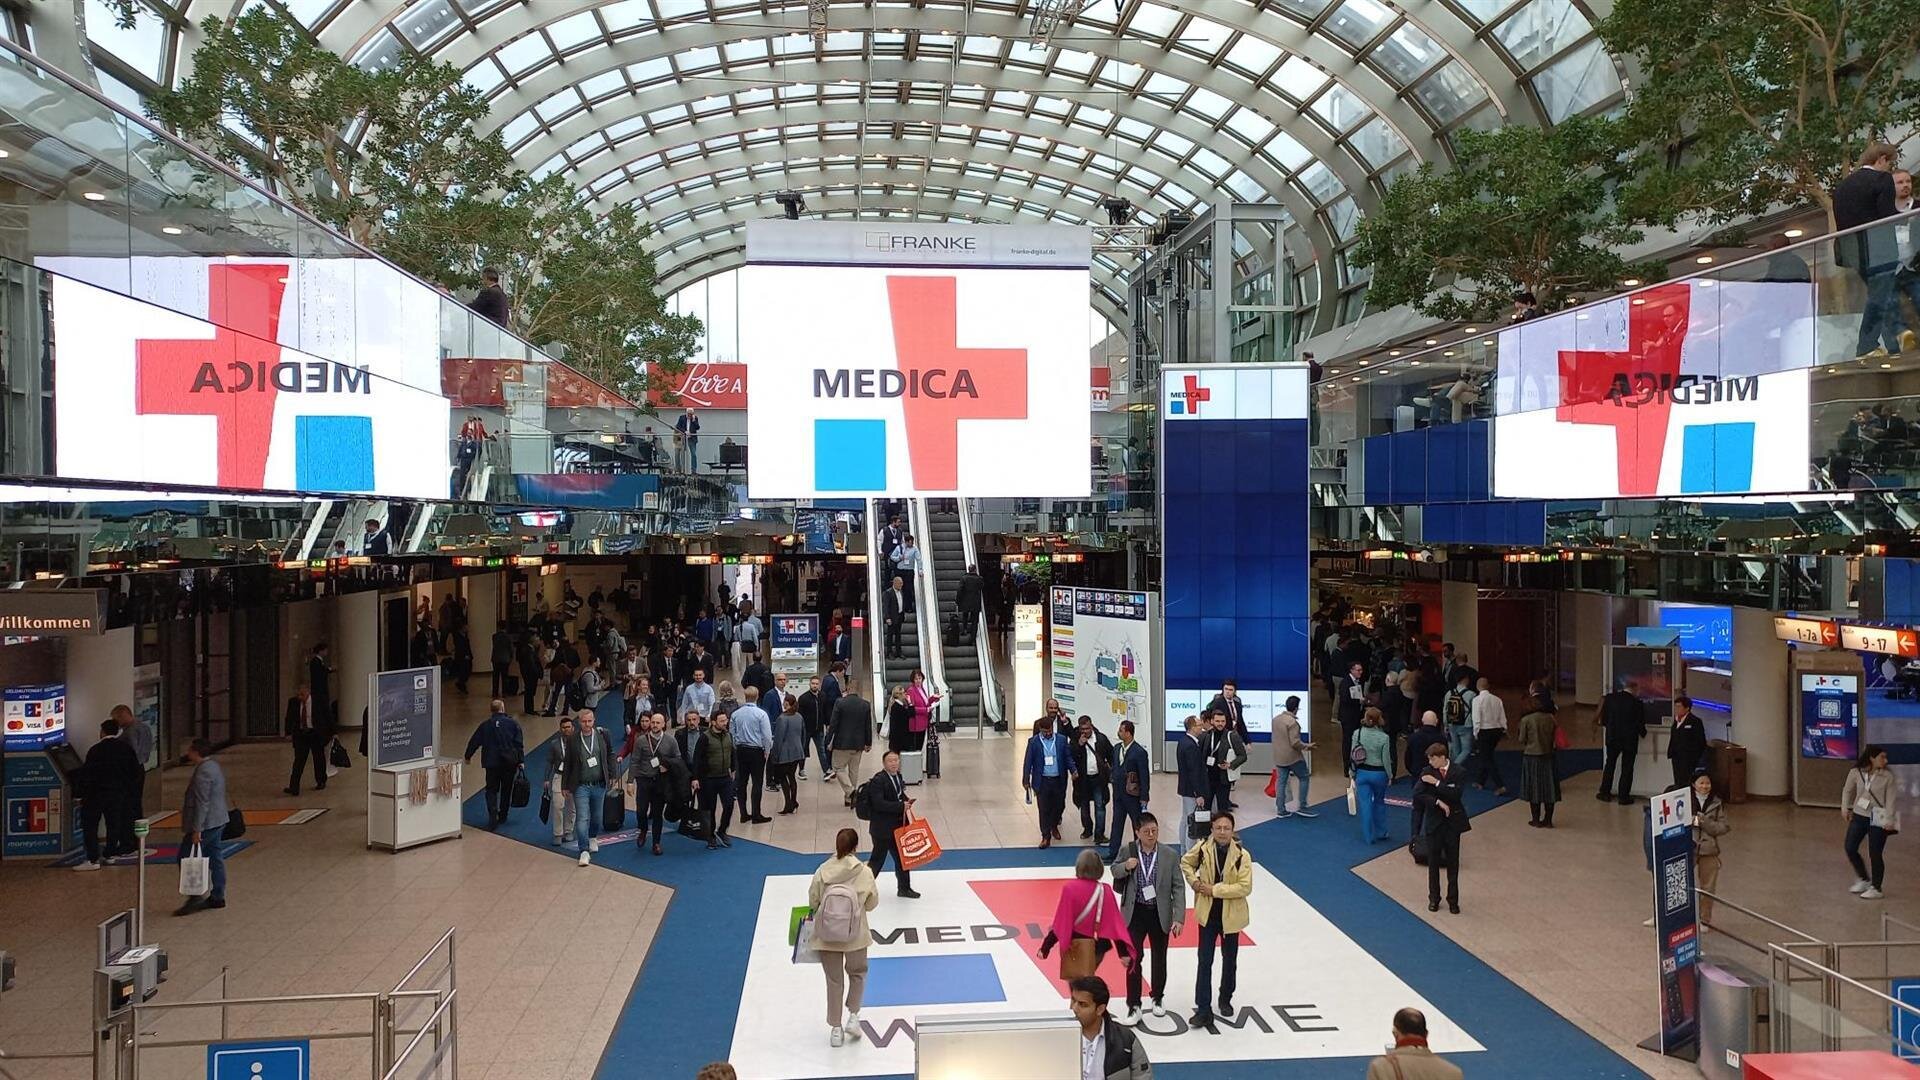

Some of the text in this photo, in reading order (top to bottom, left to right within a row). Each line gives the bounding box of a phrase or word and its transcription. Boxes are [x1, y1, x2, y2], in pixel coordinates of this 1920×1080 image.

[892, 236, 976, 249] FRANKE
[671, 361, 730, 407] Love
[813, 368, 979, 399] MEDICA
[1796, 628, 1817, 641] 1-7a
[869, 923, 1052, 945] MEDI
